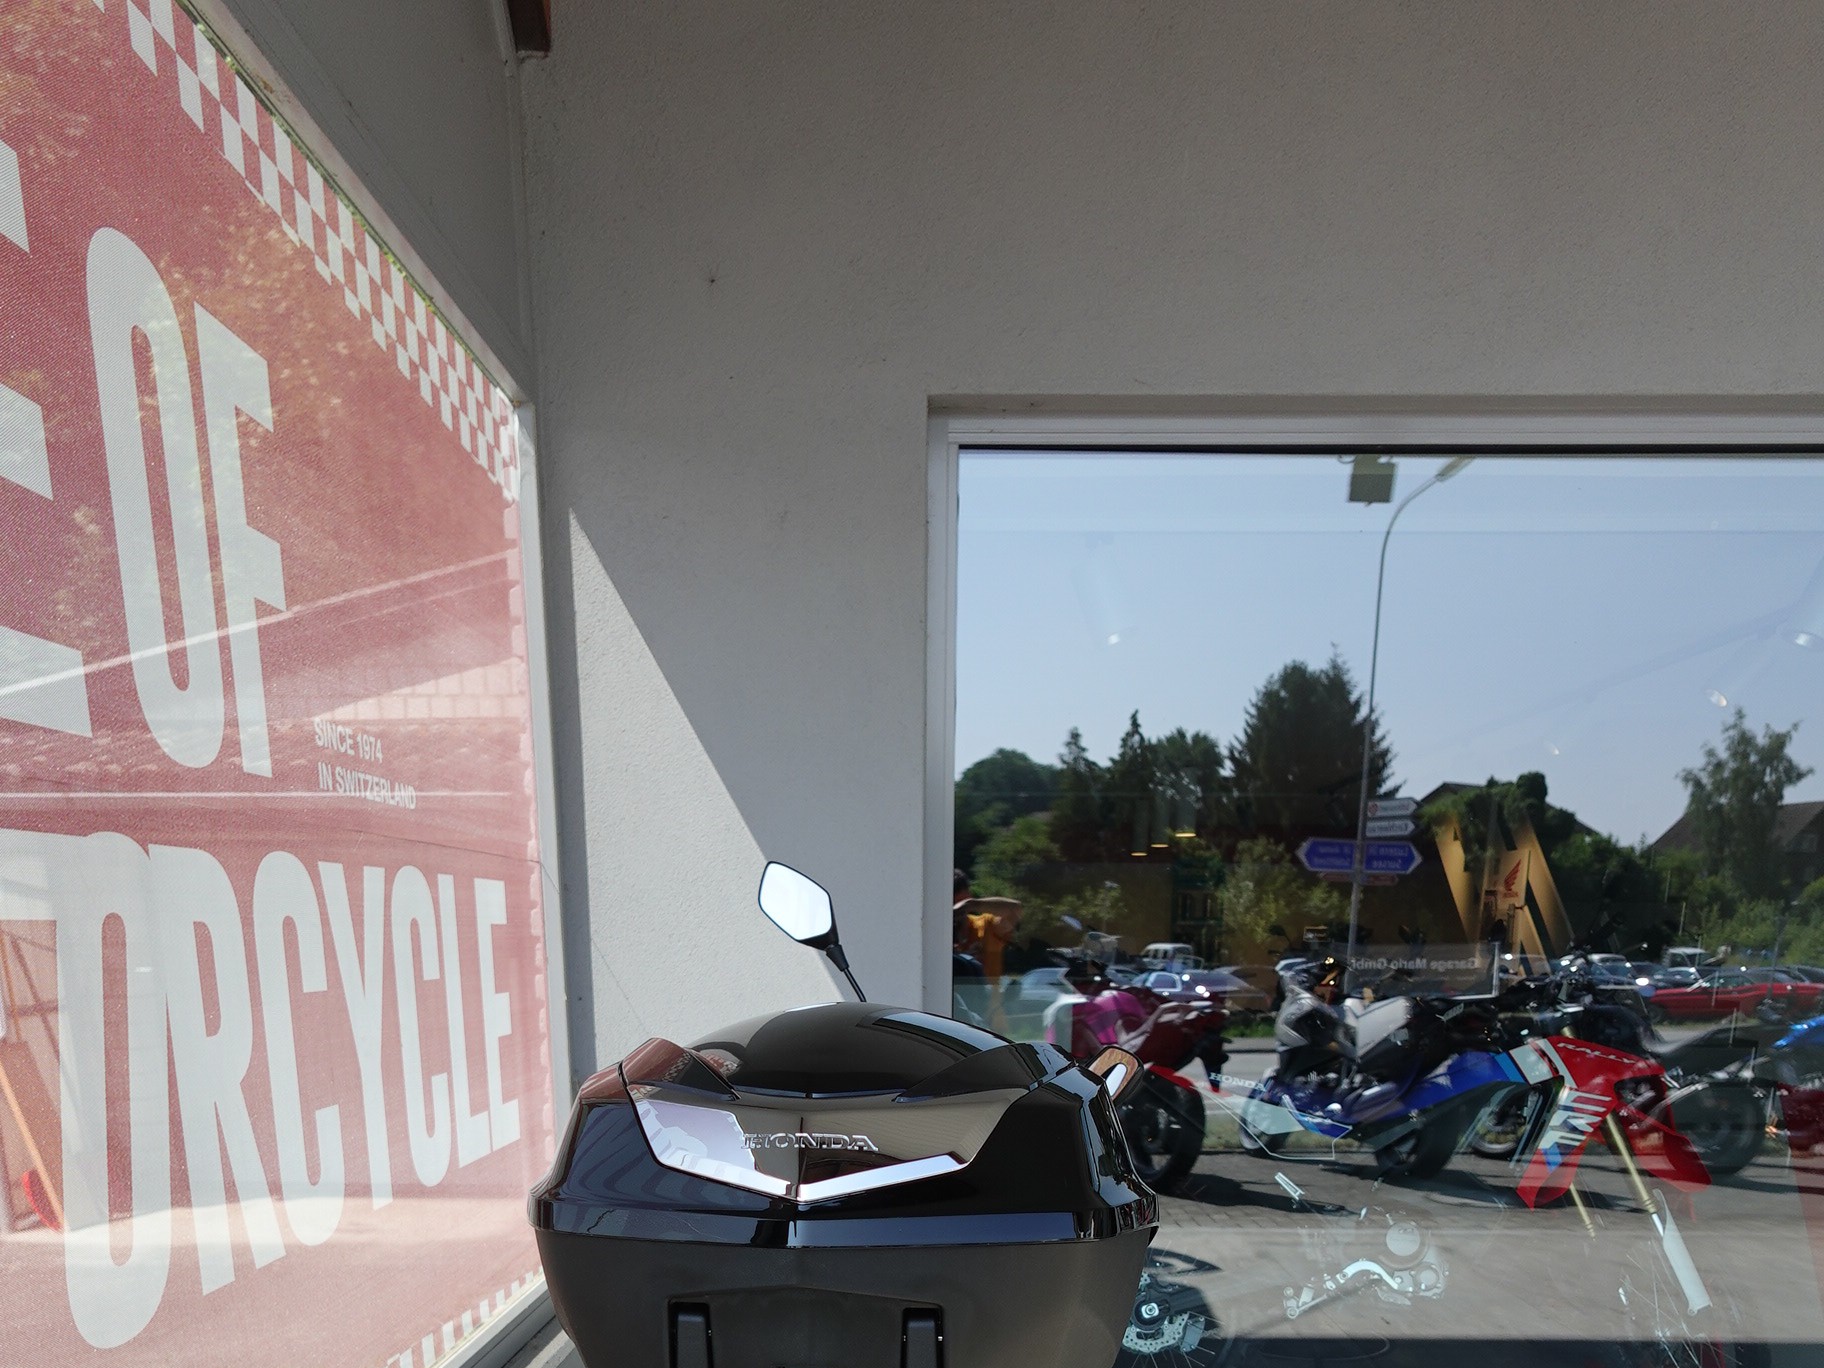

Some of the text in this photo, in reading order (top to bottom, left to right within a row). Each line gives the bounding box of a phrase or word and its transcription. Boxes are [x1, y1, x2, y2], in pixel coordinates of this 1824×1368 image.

[86, 227, 286, 778] OF
[314, 719, 383, 764] SINCE 1974
[318, 761, 417, 810] IN SWITZERLAND
[1556, 1042, 1637, 1065] RALLY
[1208, 1071, 1267, 1093] HONDA
[741, 1132, 879, 1152] HONDA
